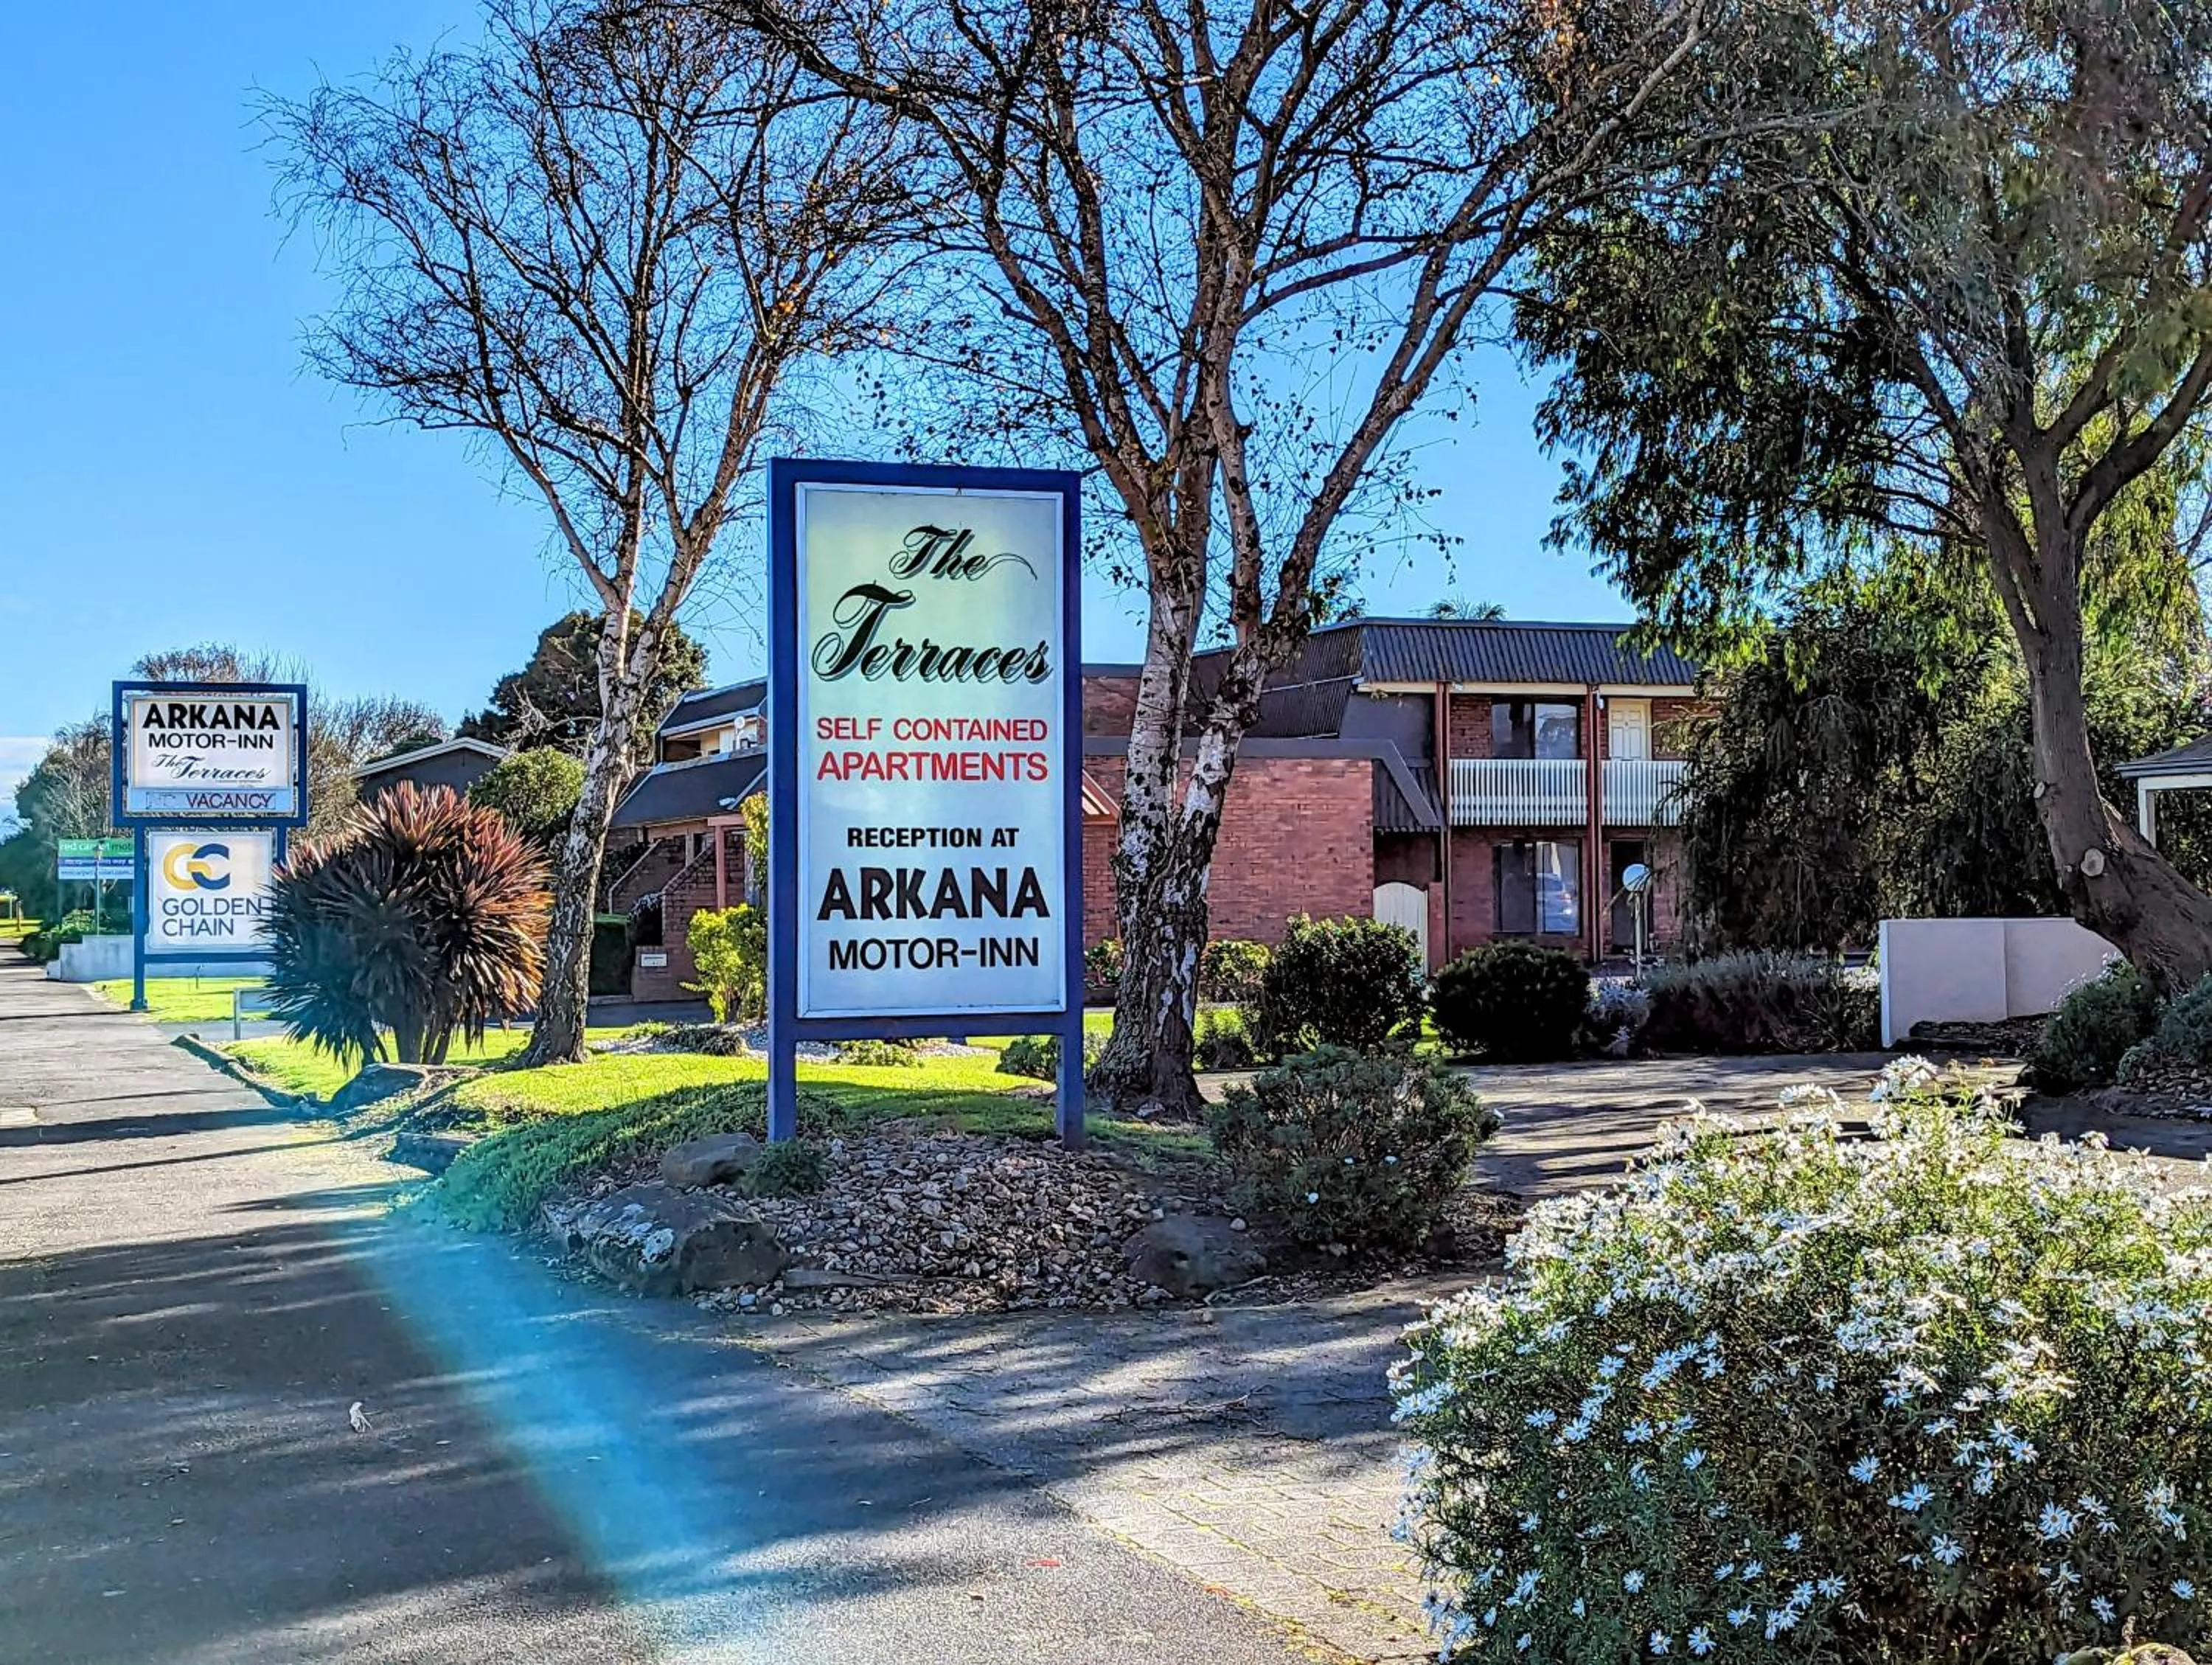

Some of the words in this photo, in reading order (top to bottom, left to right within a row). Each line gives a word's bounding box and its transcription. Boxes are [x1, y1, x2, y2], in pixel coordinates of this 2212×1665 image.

[888, 523, 1038, 581] The
[812, 580, 1054, 684] Terraces
[142, 703, 280, 731] ARKANA
[816, 717, 883, 740] SELF
[893, 718, 1048, 742] CONTAINED
[148, 732, 274, 750] MOTOR-INN
[151, 753, 184, 768] The
[170, 755, 271, 780] Terraces
[816, 751, 1048, 782] APARTMENTS
[185, 792, 274, 810] VACANCY
[846, 827, 982, 848] RECEPTION
[990, 827, 1020, 847] AT
[162, 897, 261, 917] GOLDEN
[816, 866, 1051, 921] ARKANA
[161, 918, 234, 937] CHAIN
[828, 936, 1040, 970] MOTOR-INN
